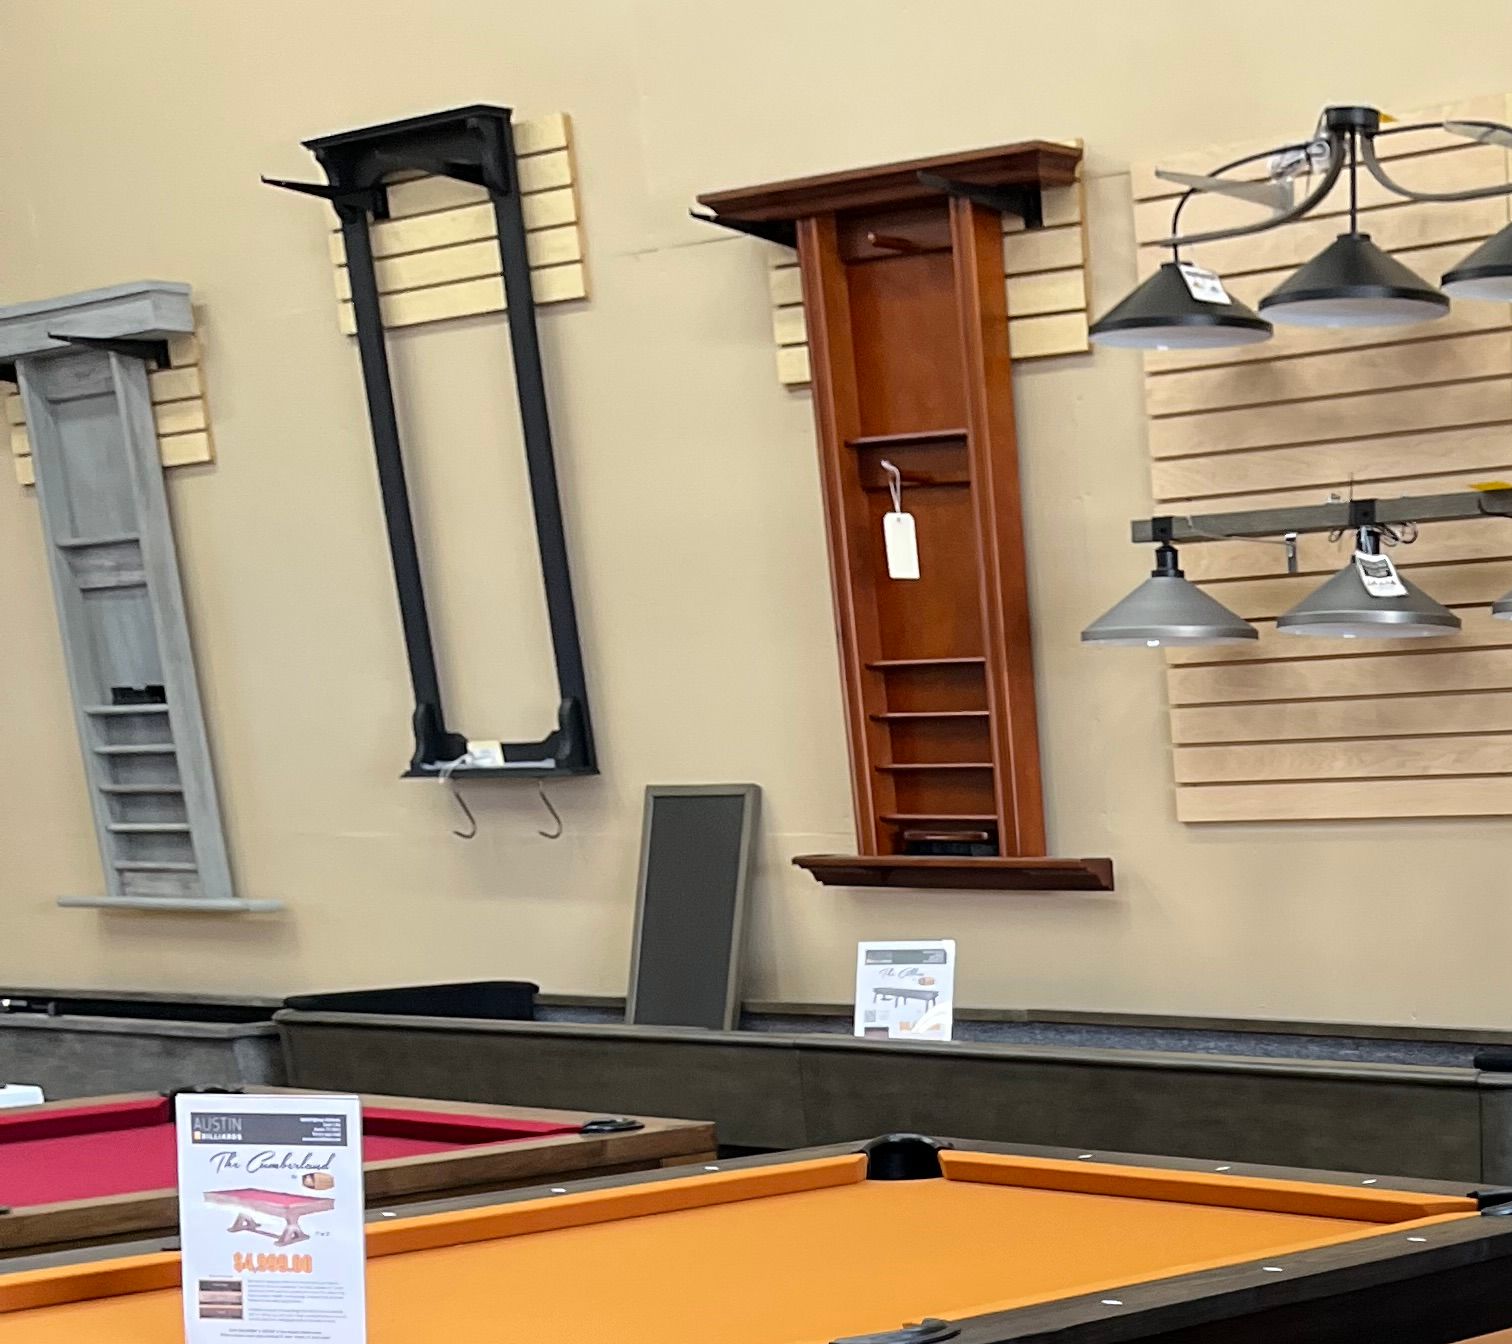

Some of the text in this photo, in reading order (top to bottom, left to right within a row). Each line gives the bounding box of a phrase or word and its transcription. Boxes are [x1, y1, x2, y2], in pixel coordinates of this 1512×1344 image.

[193, 1116, 243, 1131] AUSTIN
[210, 1150, 336, 1174] The Cumberland
